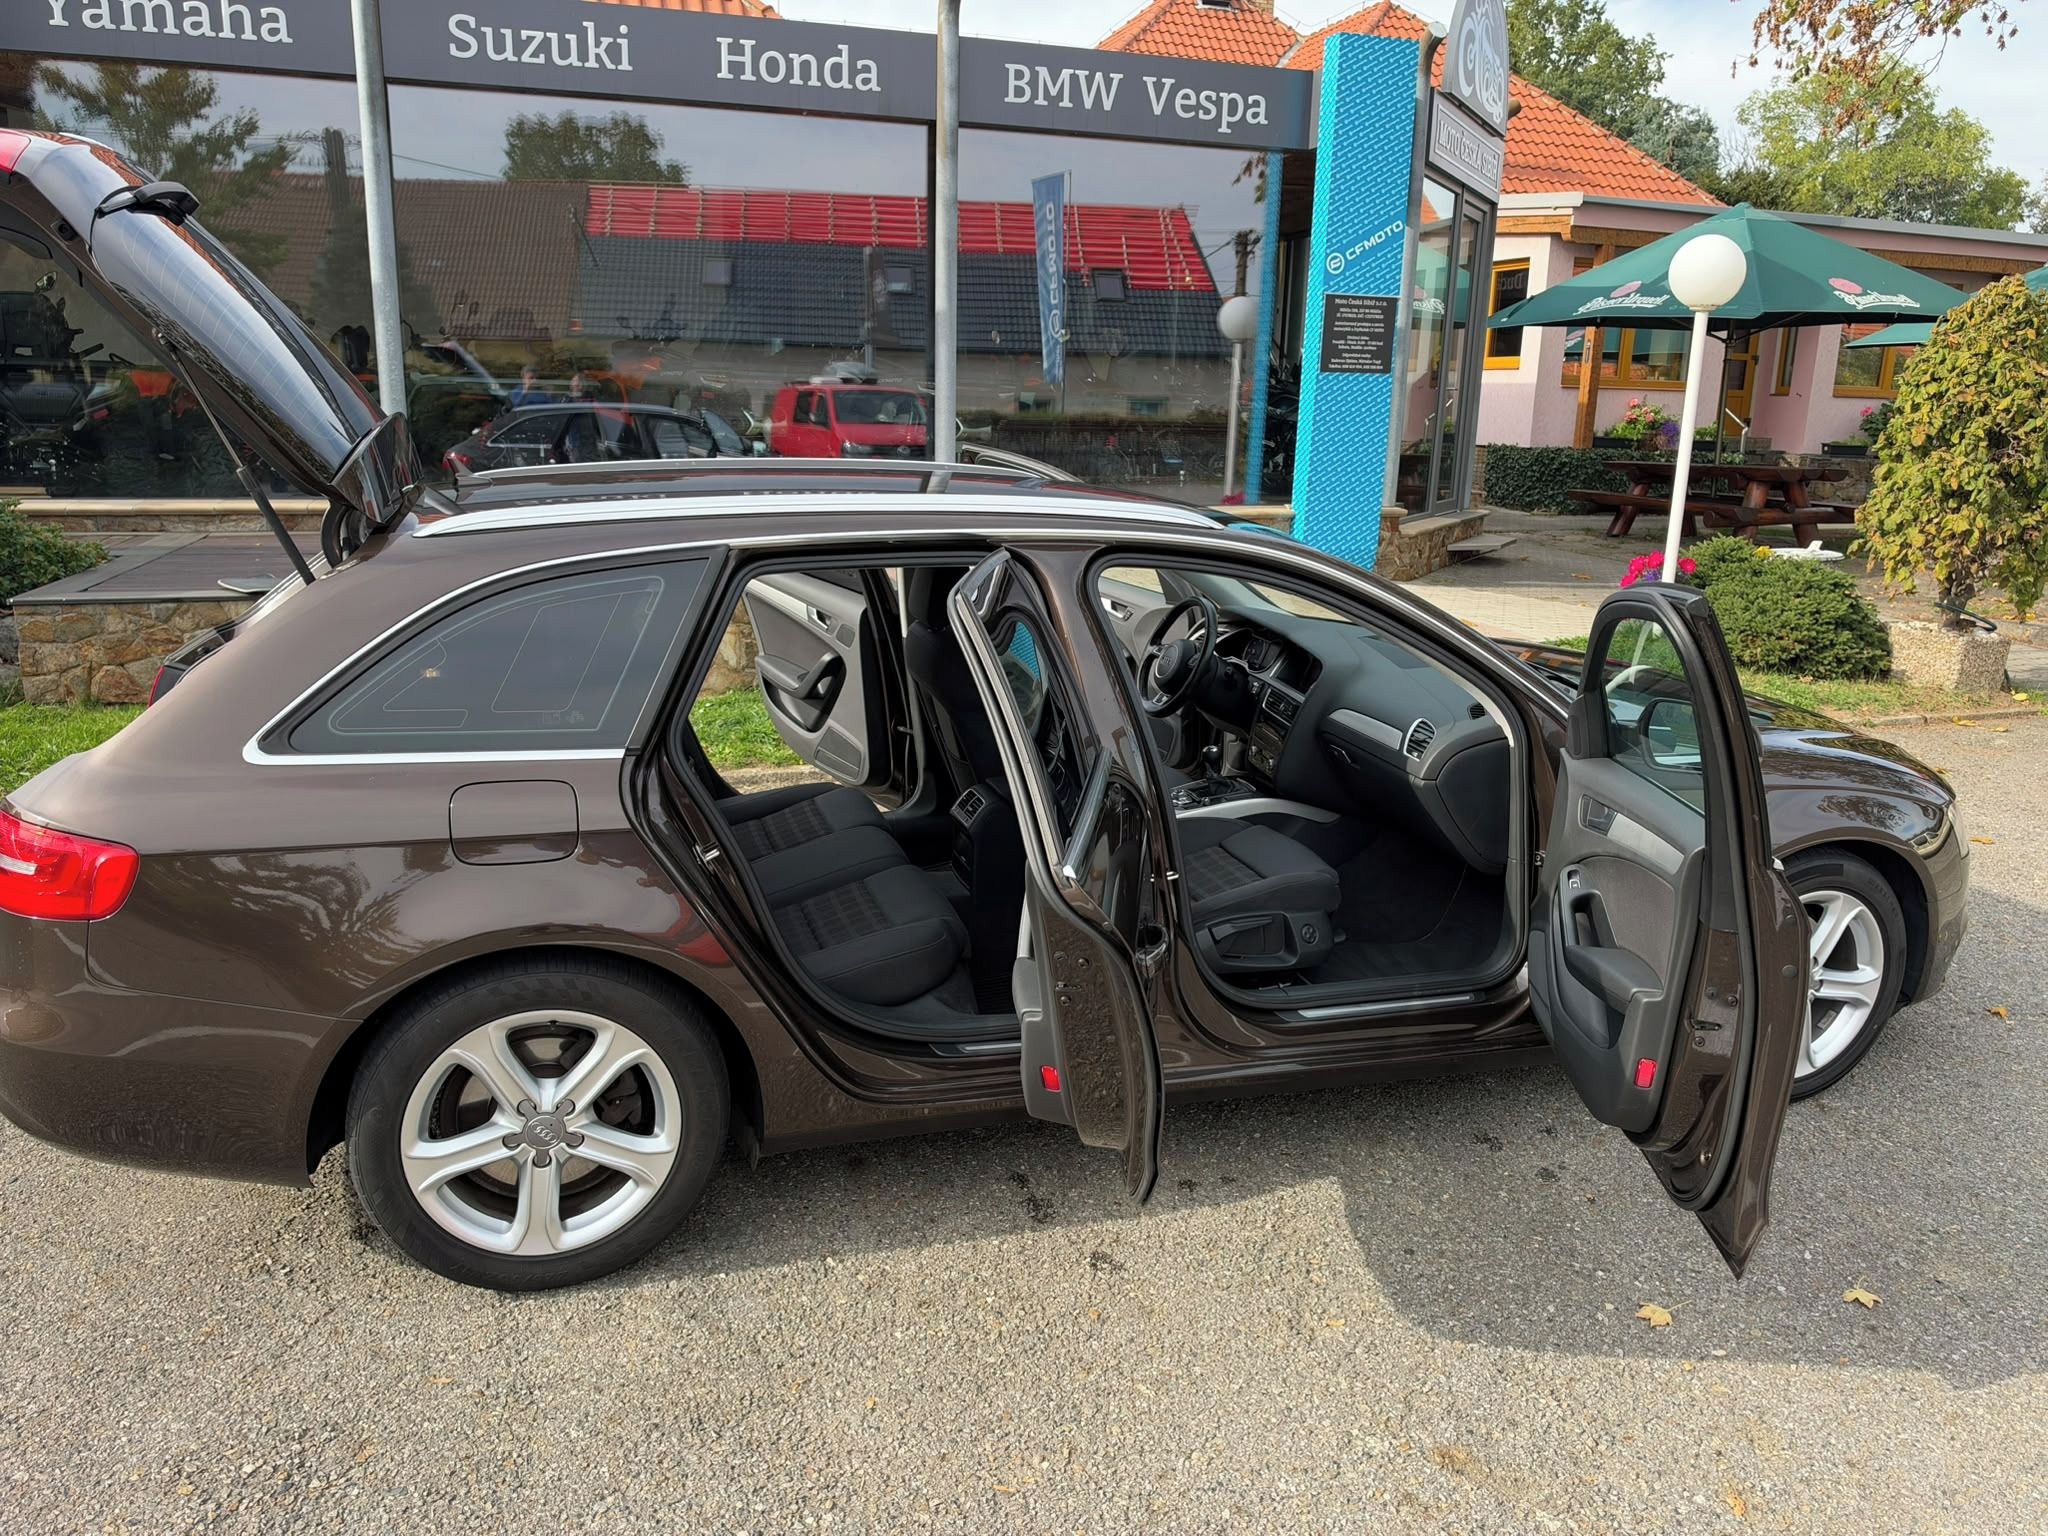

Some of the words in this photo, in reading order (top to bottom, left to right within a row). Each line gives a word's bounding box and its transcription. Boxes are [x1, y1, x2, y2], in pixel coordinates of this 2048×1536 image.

[48, 0, 294, 44] Yamaha
[448, 13, 634, 72] Suzuki
[716, 36, 882, 93] Honda
[1005, 63, 1124, 112] BMW
[1143, 76, 1269, 134] Vespa
[1439, 119, 1460, 155] MOTO
[1460, 131, 1481, 171] ČESKÁ
[1345, 220, 1404, 261] CFMOTO
